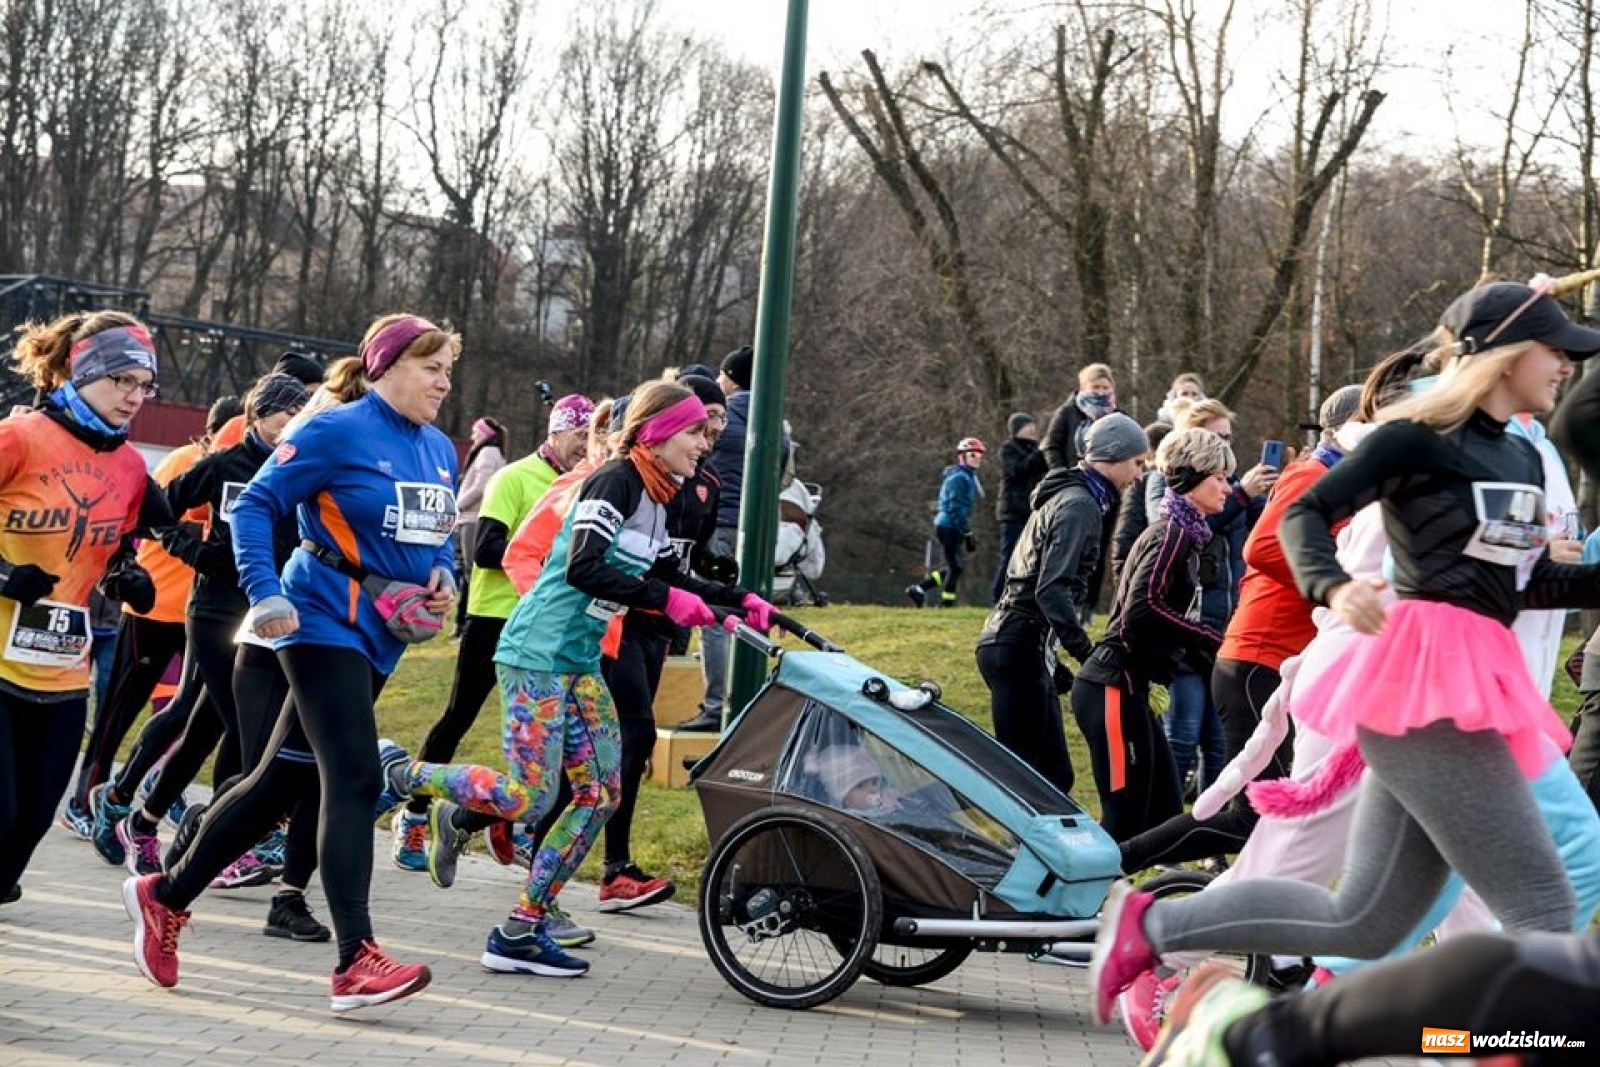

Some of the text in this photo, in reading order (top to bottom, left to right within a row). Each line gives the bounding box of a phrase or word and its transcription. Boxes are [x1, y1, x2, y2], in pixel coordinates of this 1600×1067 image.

[417, 489, 446, 513] 128
[6, 507, 71, 529] RUN
[90, 525, 117, 547] TE
[48, 608, 70, 633] 15
